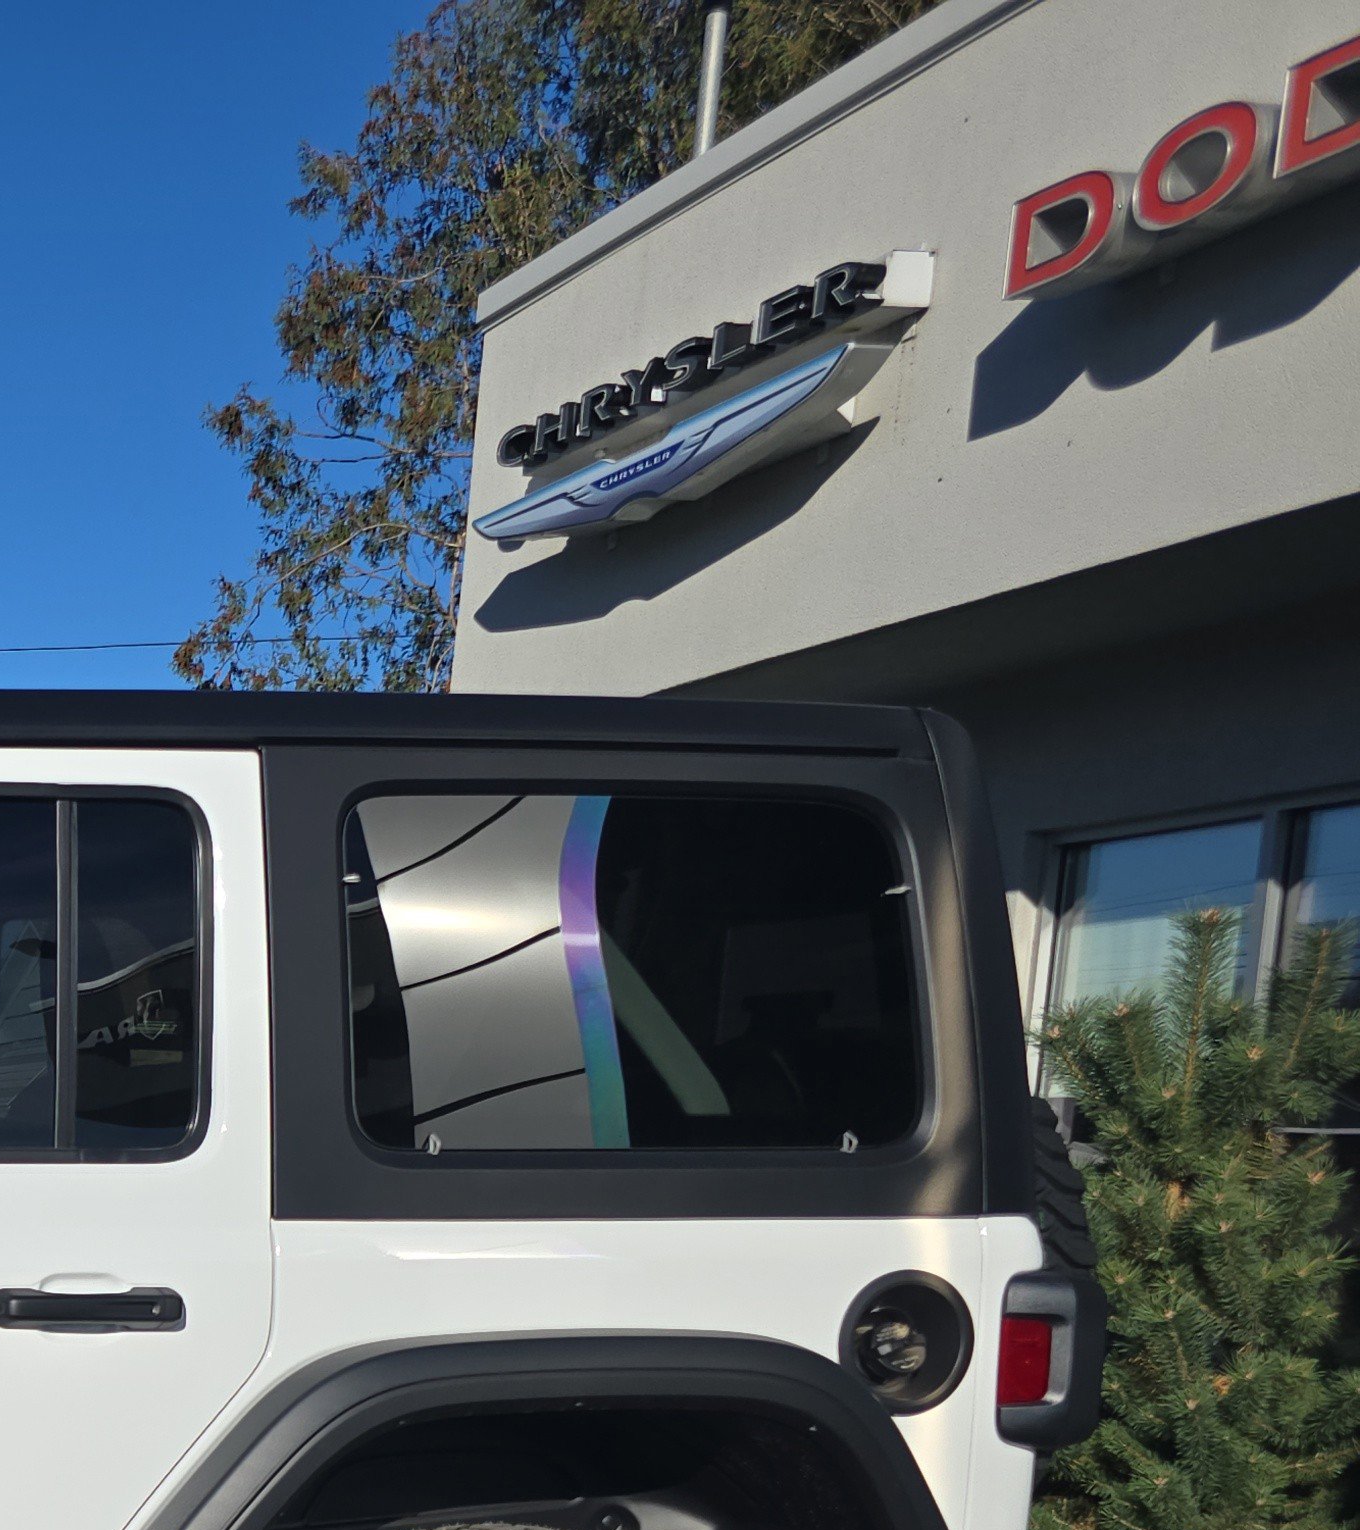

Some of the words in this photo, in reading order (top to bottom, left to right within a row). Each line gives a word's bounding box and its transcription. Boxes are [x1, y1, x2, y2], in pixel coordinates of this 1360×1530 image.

[1001, 34, 1360, 300] DOD
[496, 261, 883, 468] CHRYSLER
[600, 450, 671, 489] CHRYSLER
